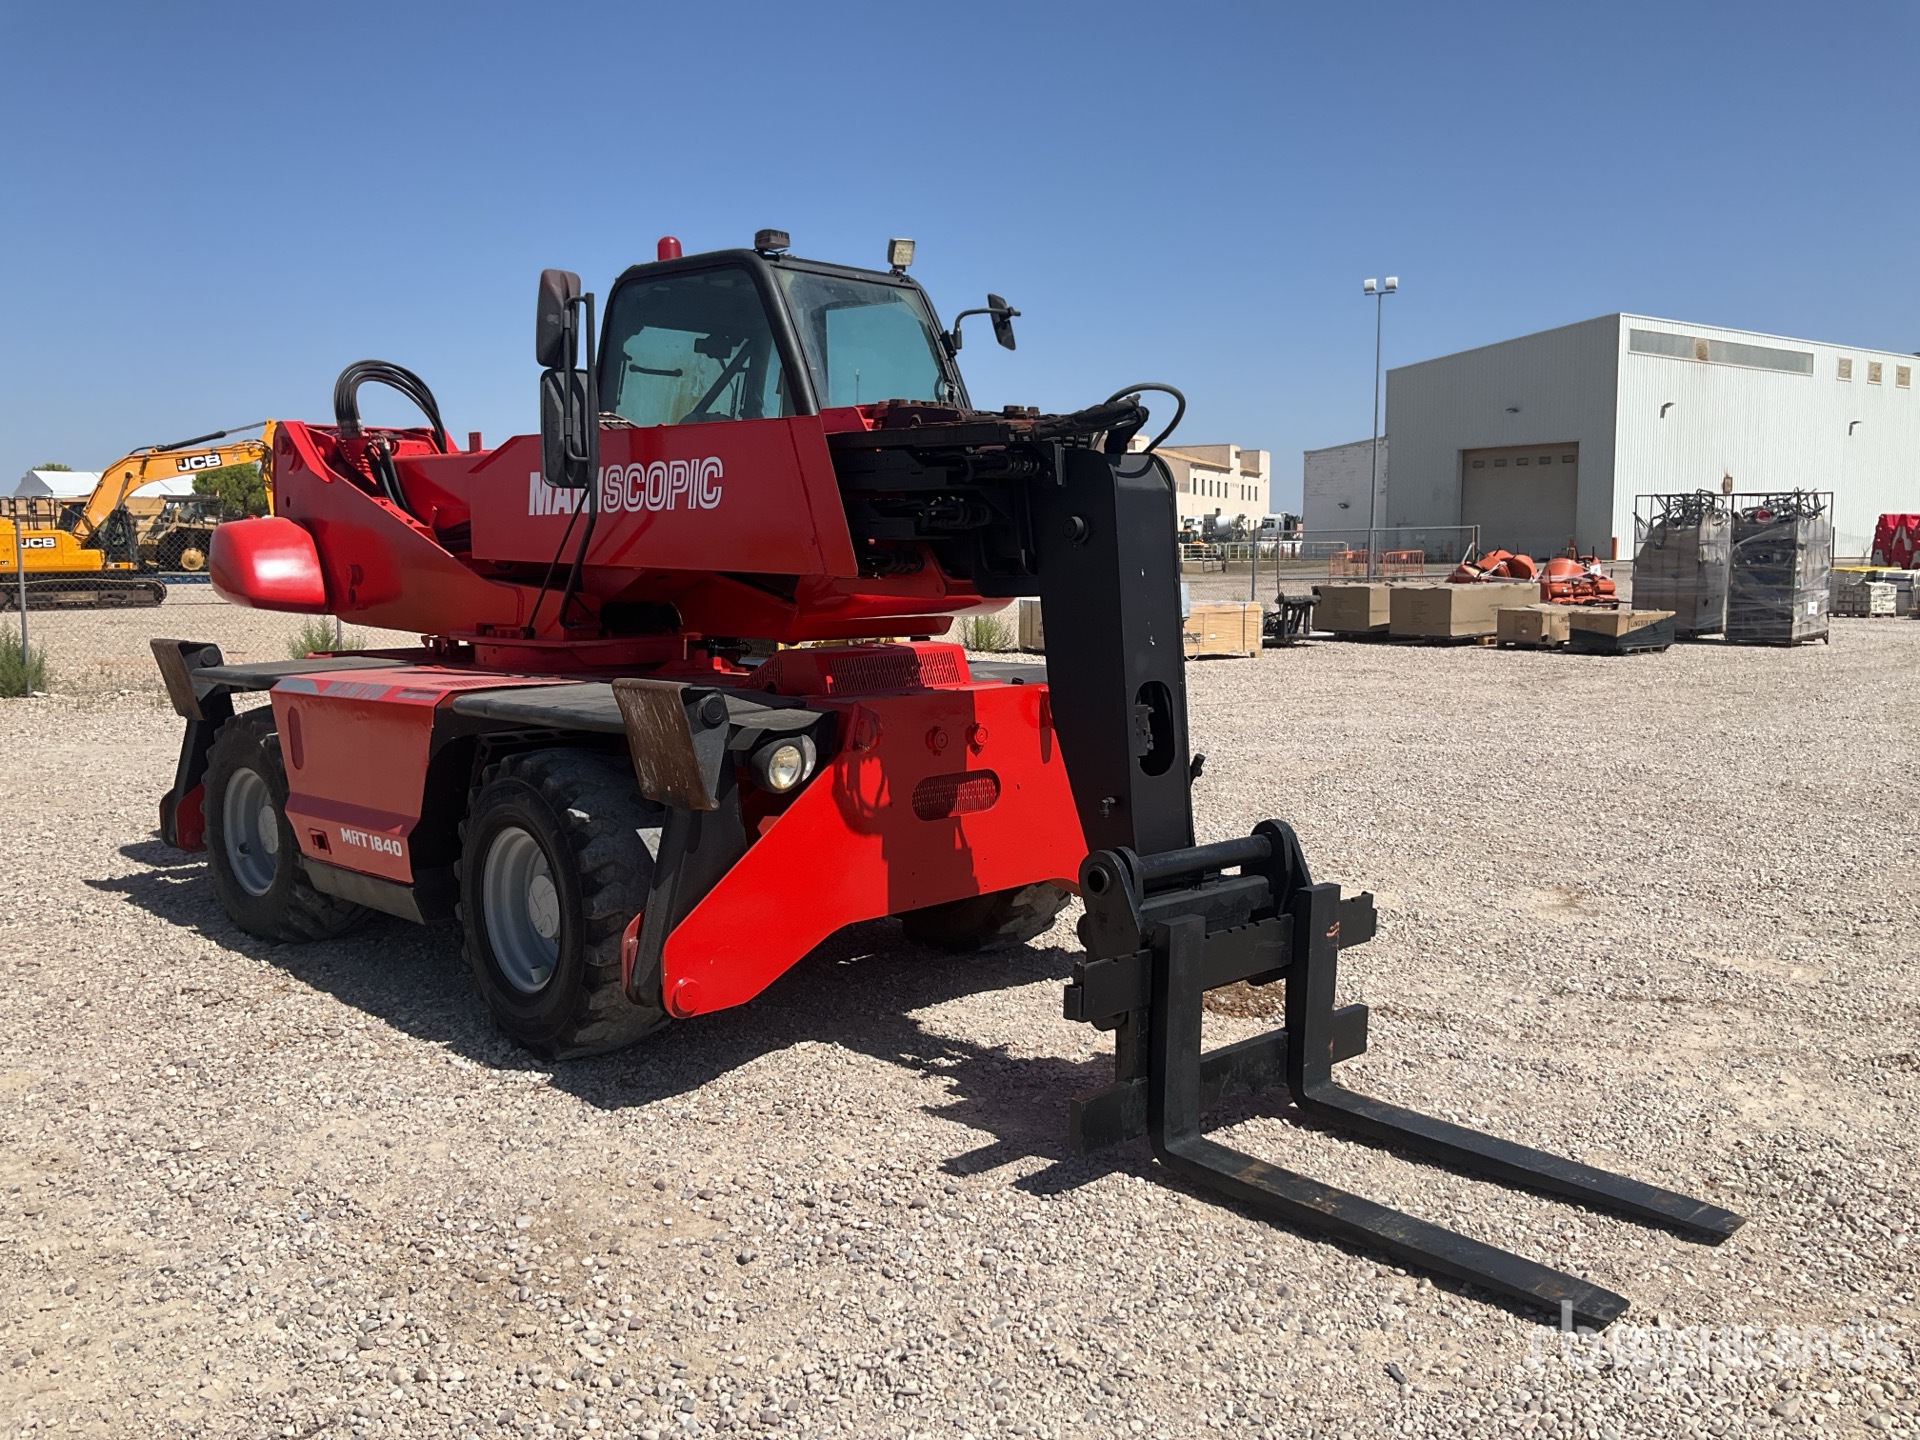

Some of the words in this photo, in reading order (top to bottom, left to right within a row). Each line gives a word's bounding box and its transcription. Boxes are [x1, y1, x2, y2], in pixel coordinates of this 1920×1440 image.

[178, 454, 221, 471] JCB
[21, 537, 55, 549] JCB
[340, 827, 403, 857] MRT1840
